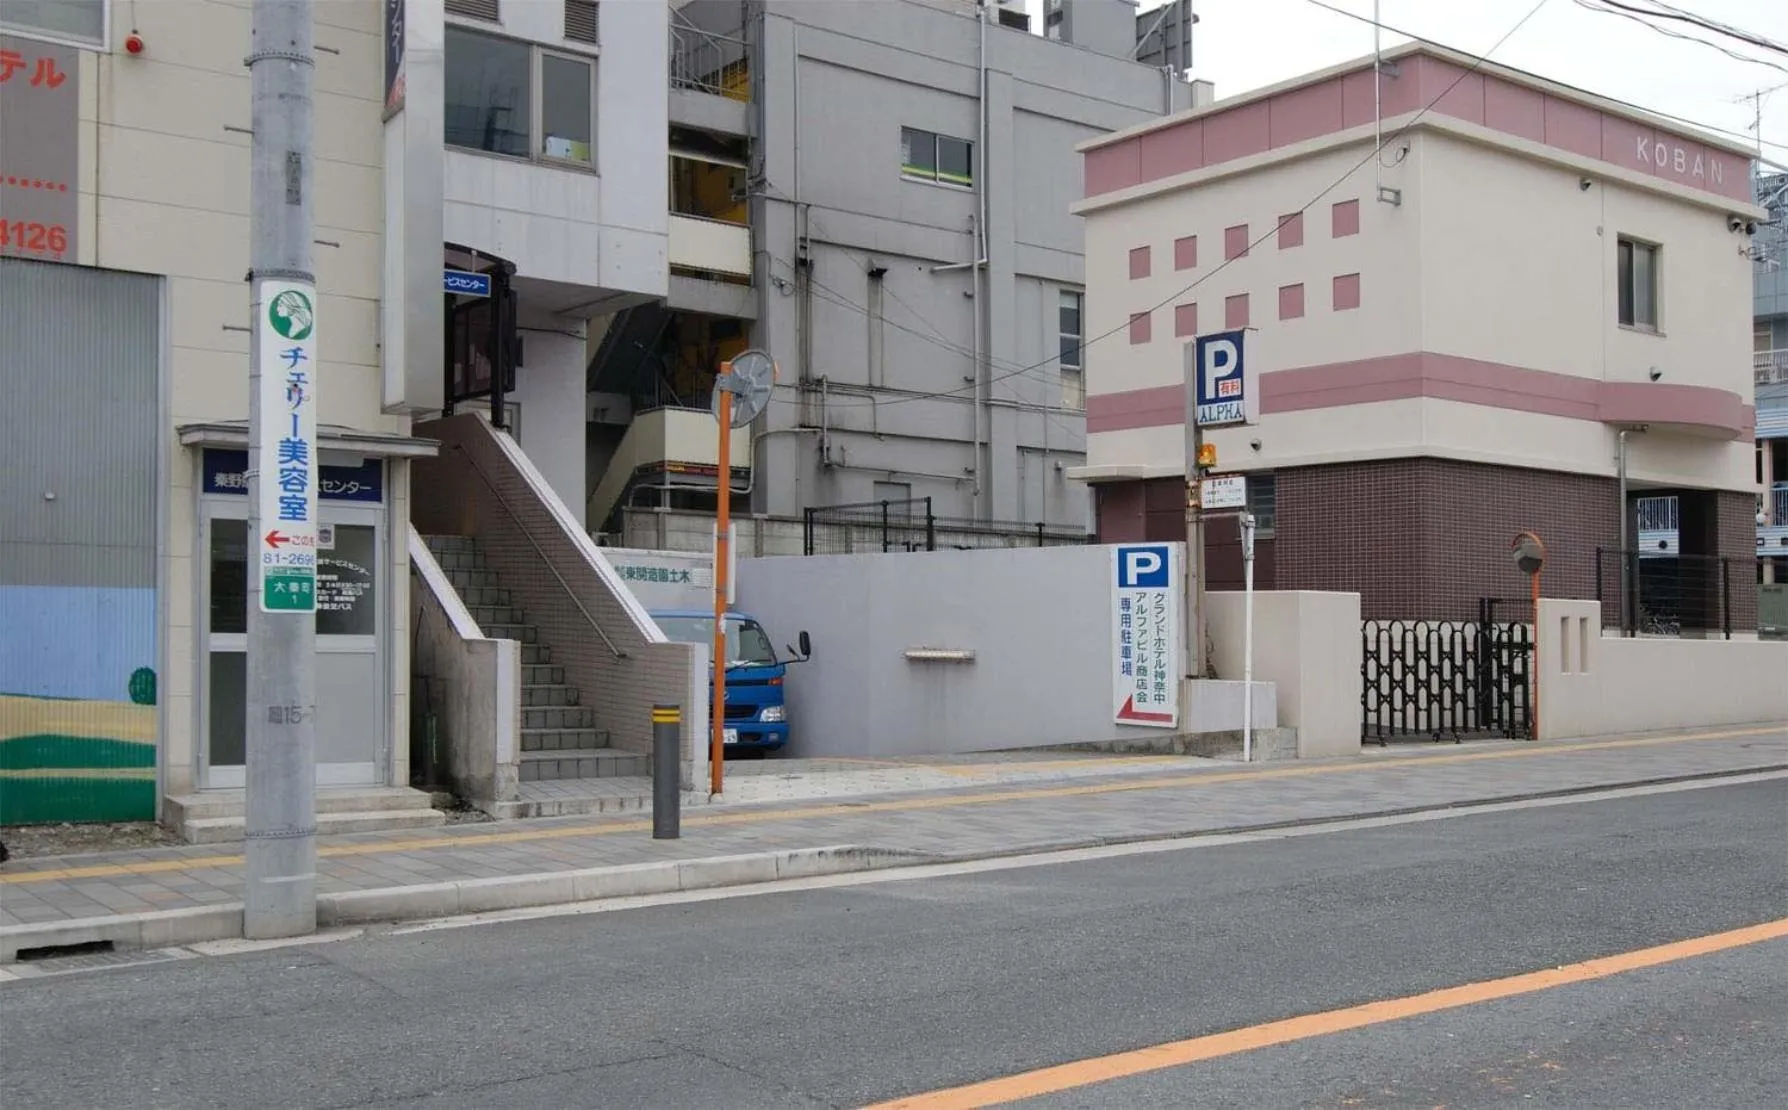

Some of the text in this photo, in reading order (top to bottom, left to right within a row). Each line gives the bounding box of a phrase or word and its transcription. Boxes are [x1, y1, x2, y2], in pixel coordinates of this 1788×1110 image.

[1636, 136, 1723, 184] KOBAN
[1205, 340, 1238, 399] P
[1220, 382, 1240, 395] 有料
[279, 346, 308, 521] チェリー美容室
[1200, 403, 1242, 423] ALPHA
[1126, 552, 1161, 585] P
[1120, 597, 1132, 677] 専用駐車場
[1135, 591, 1148, 704] アルファビル商店会
[1153, 592, 1166, 705] グランドホテル神奈中
